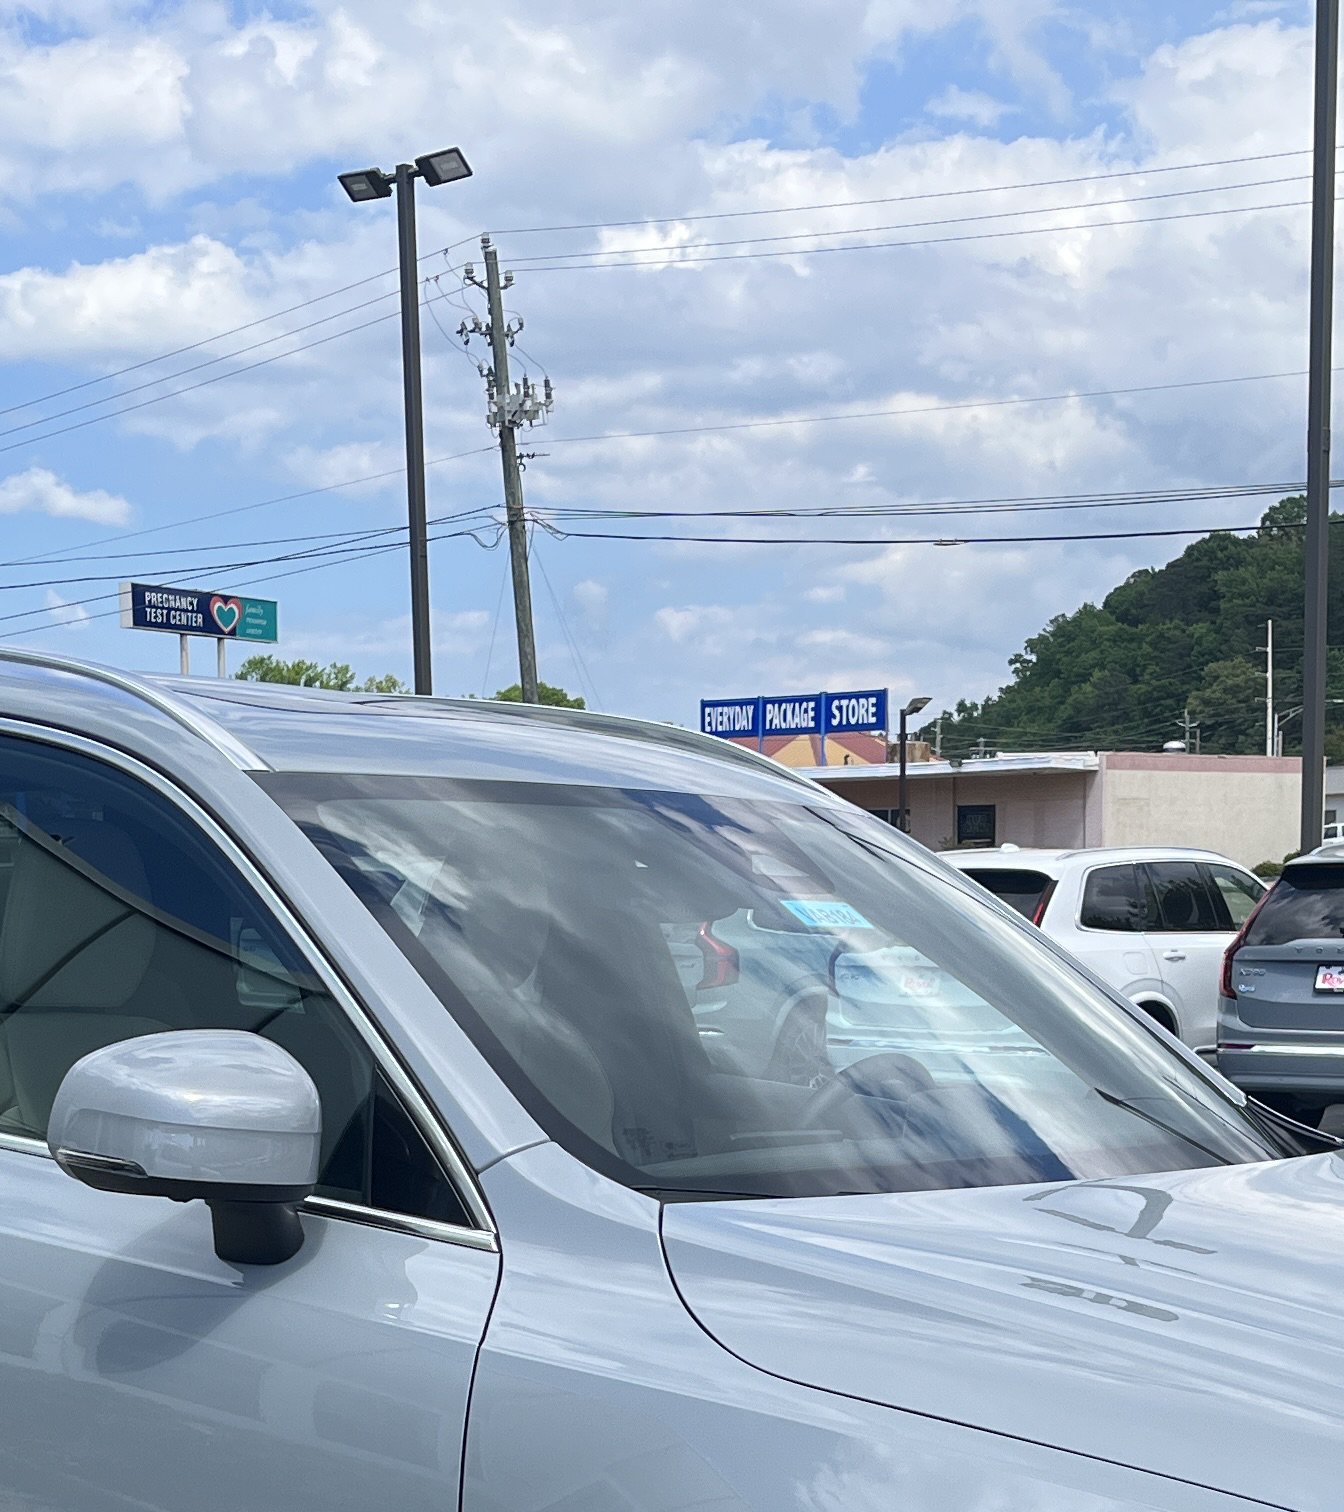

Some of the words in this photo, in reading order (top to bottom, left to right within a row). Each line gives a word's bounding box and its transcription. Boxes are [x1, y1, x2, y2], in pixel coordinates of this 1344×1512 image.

[144, 591, 198, 611] PREGNANCY
[145, 607, 167, 623] TEST
[170, 611, 203, 627] CENTER
[705, 705, 754, 732] EVERYDAY
[765, 701, 815, 730] PACKAGE
[831, 697, 877, 726] STORE
